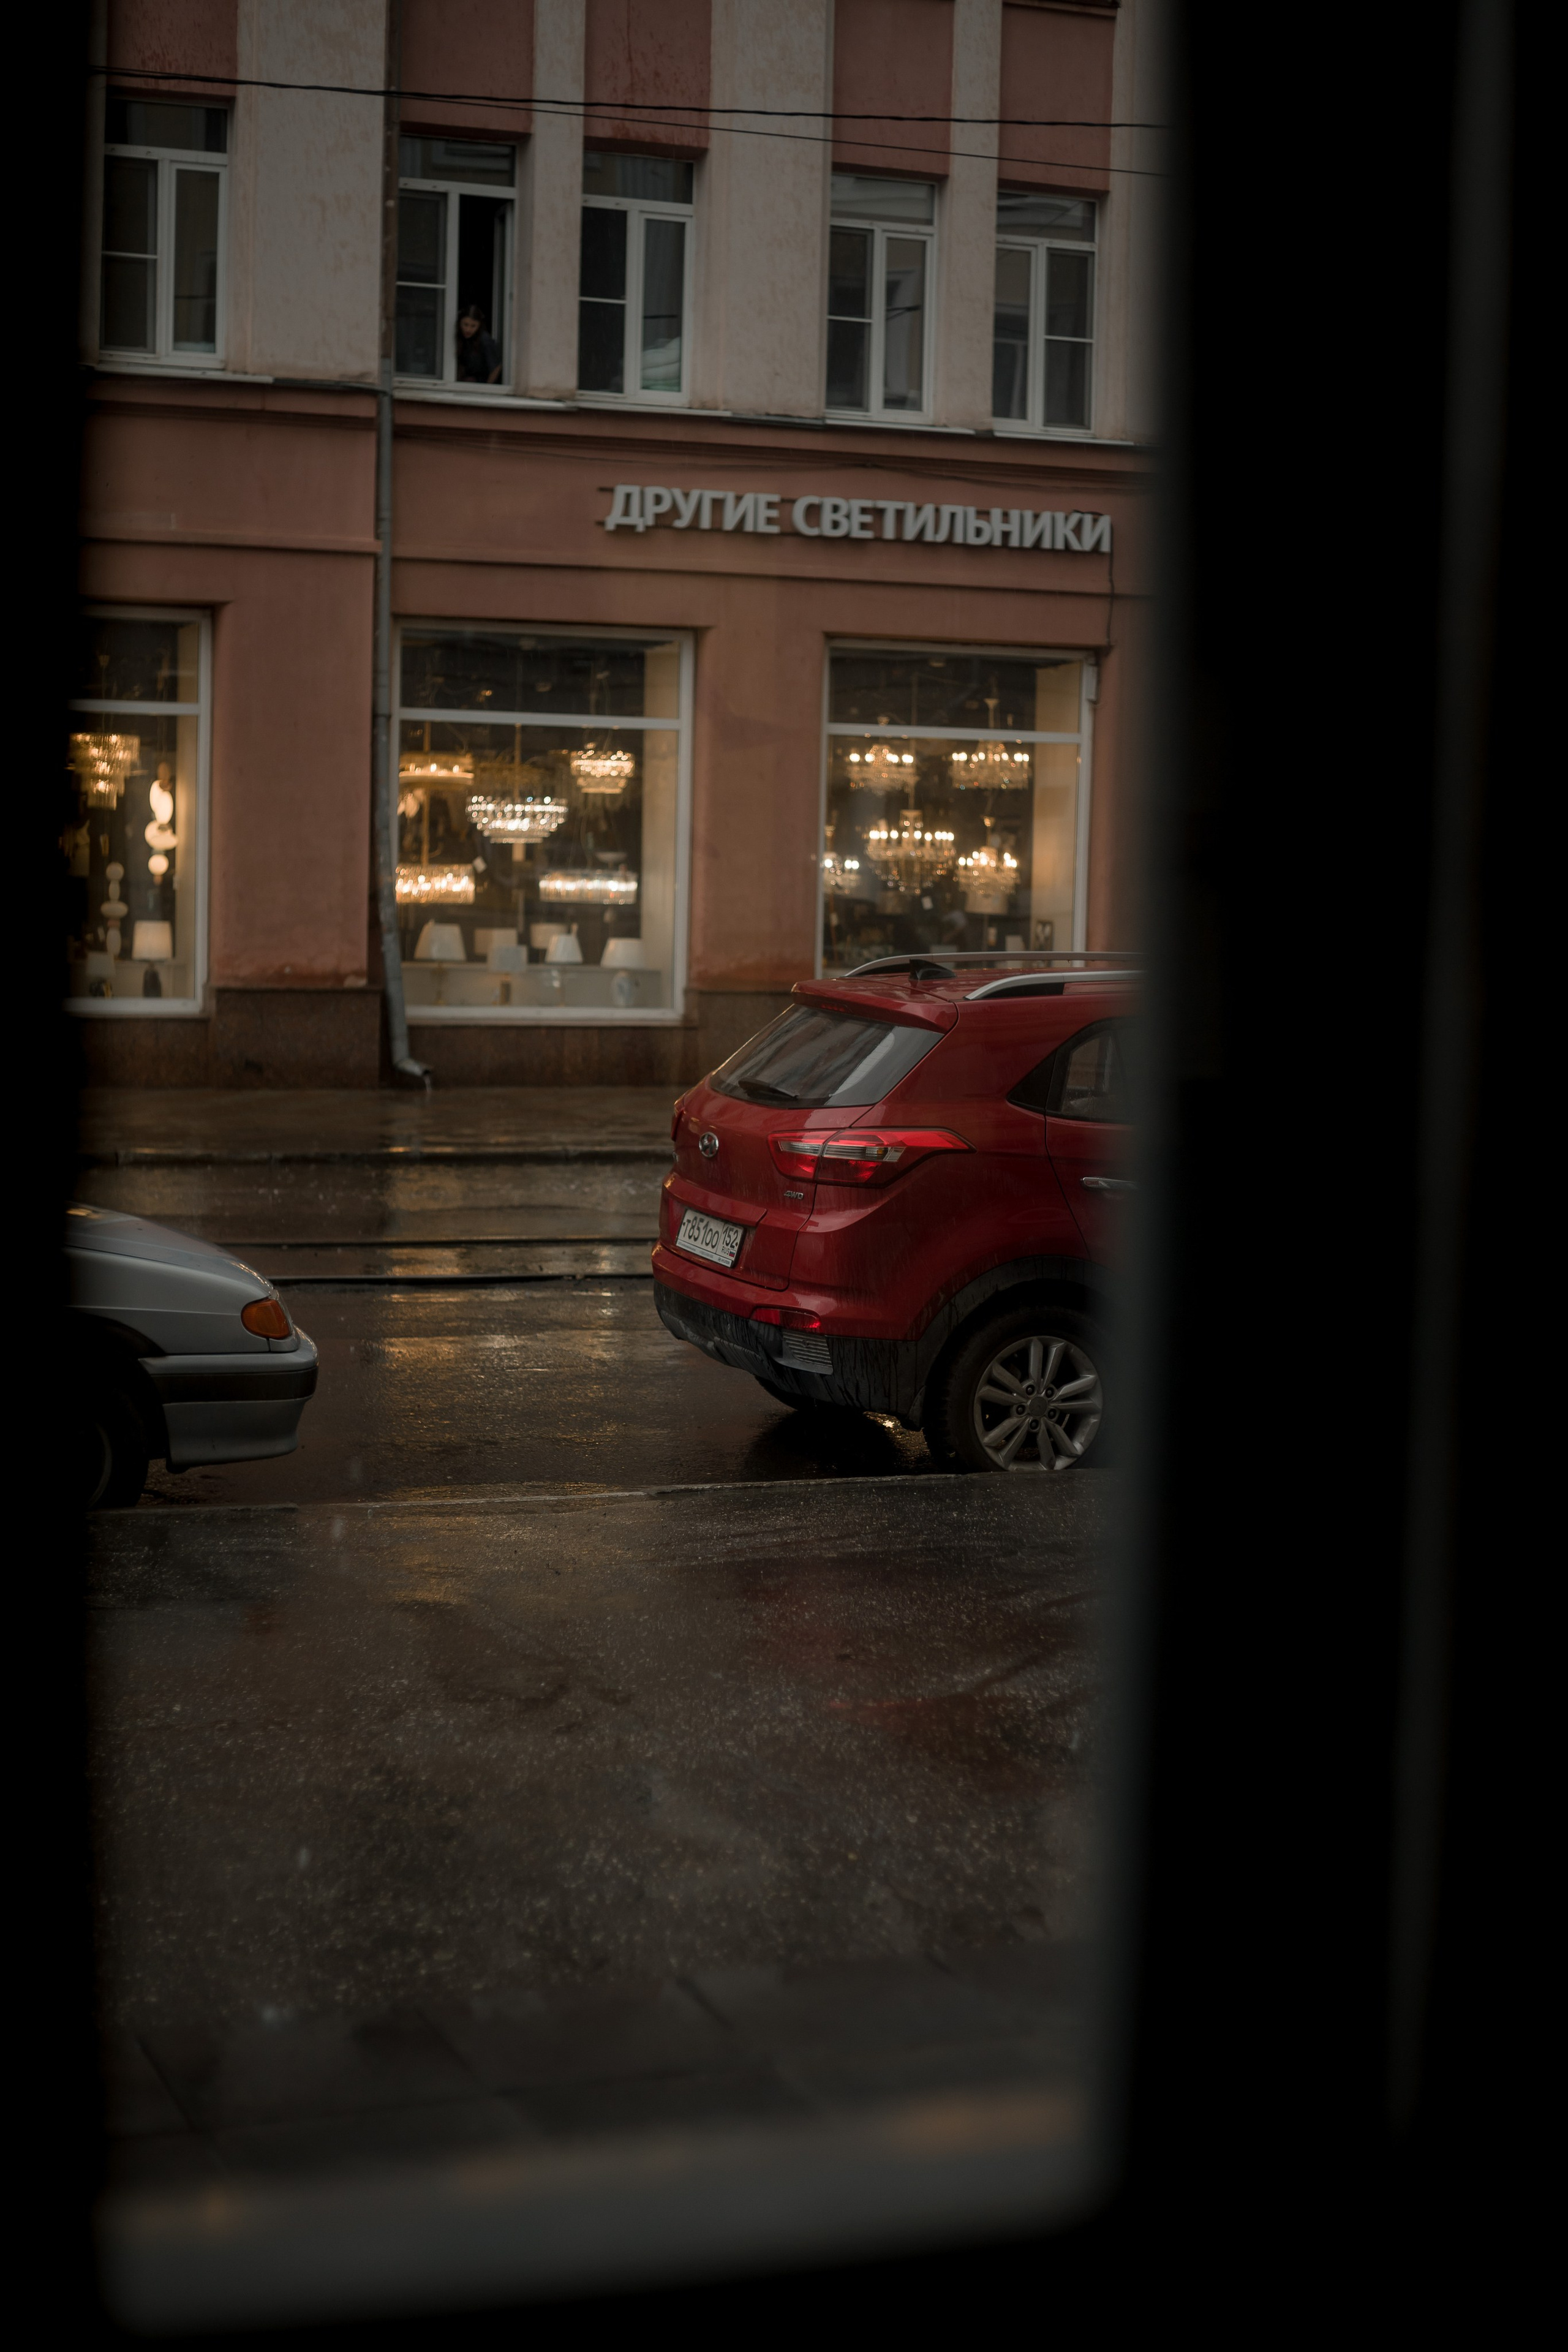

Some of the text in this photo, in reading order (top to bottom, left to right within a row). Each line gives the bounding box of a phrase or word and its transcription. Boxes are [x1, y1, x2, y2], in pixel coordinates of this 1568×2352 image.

[605, 484, 1111, 552] ДРУГИЕ СВЕТИЛЬНИКИ
[783, 1190, 804, 1200] 4WD
[723, 1226, 738, 1248] 152
